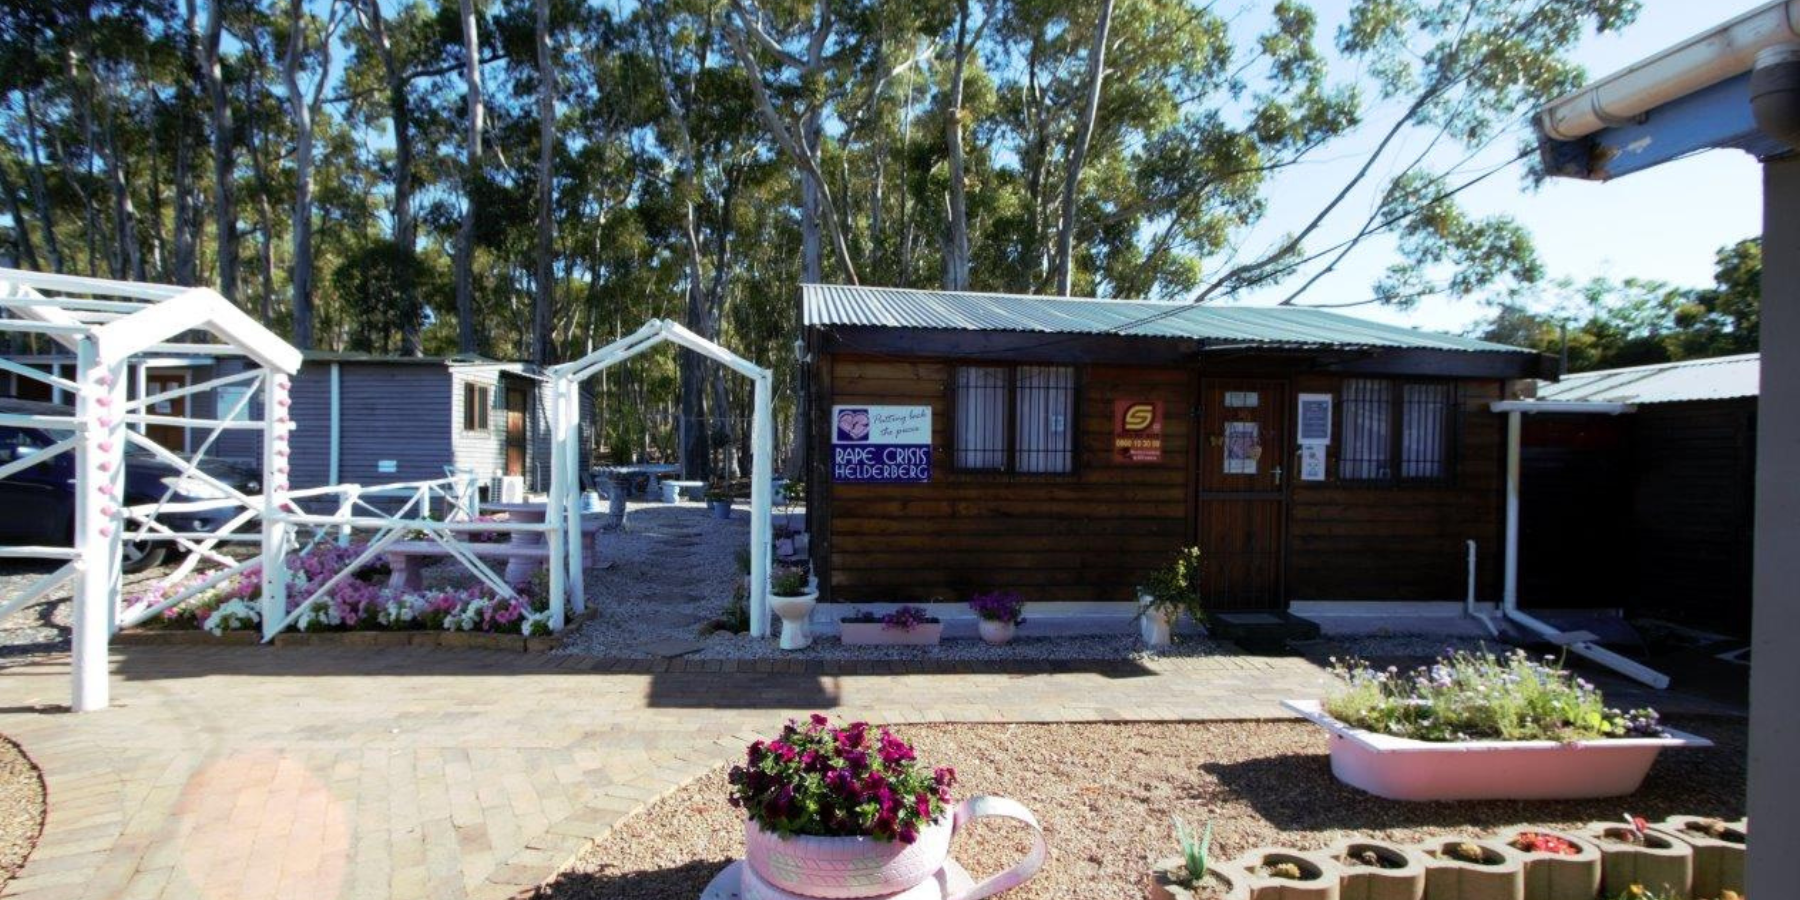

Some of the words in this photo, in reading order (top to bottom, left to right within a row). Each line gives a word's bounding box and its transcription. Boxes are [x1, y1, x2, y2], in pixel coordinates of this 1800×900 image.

[874, 413, 907, 425] Putting
[909, 408, 927, 420] back
[880, 426, 893, 436] the
[835, 447, 876, 465] RAPE
[883, 447, 929, 465] CRISIS
[835, 464, 928, 479] HELDERBERG
